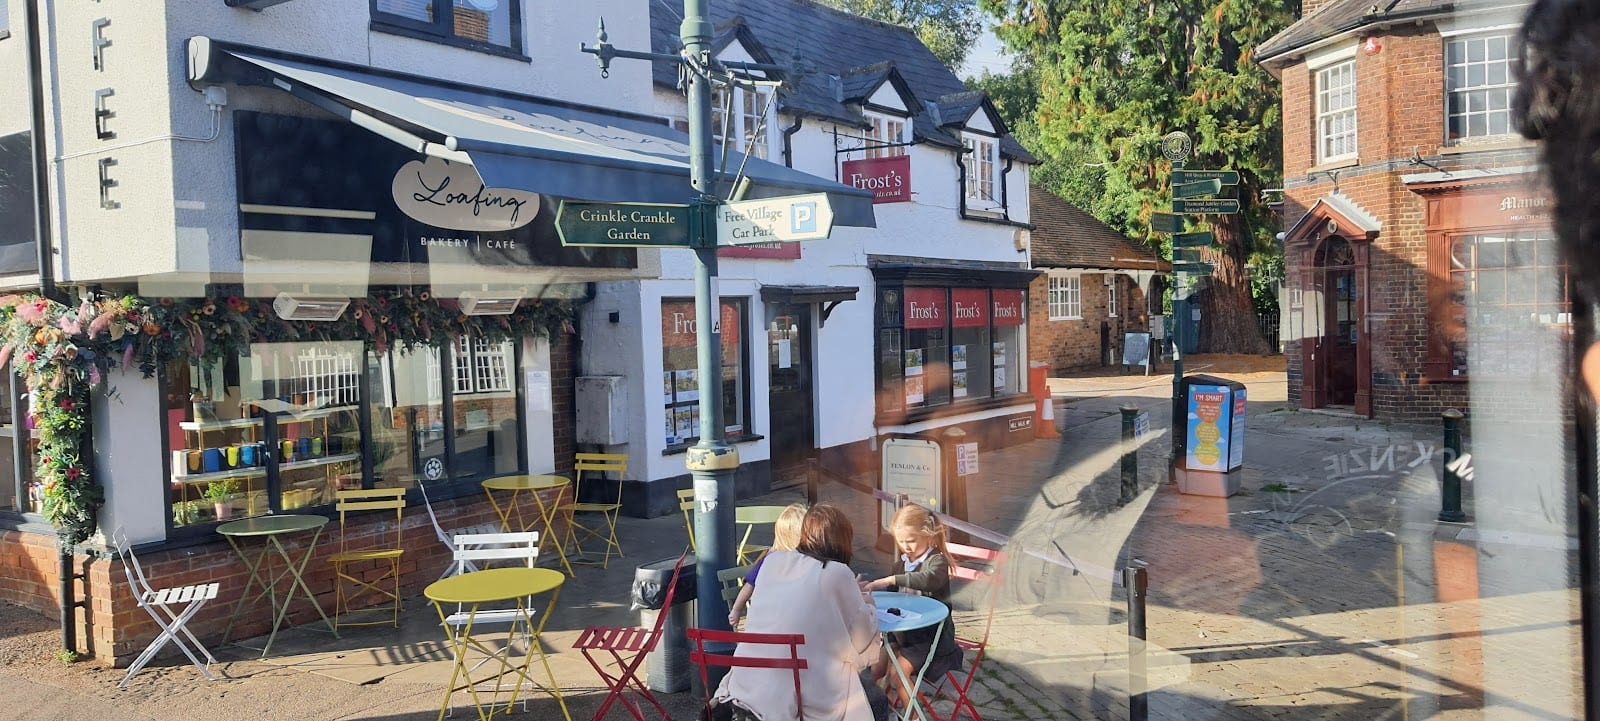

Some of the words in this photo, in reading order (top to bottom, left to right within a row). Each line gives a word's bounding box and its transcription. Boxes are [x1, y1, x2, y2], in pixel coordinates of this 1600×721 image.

[850, 170, 902, 190] Frost's
[413, 171, 527, 227] Loafing
[1499, 196, 1547, 211] Manor
[580, 209, 627, 222] Crinkle
[630, 211, 676, 224] Crankle
[724, 211, 745, 223] Free
[746, 206, 783, 222] Village
[607, 227, 651, 240] Garden
[732, 227, 750, 239] Car
[752, 224, 776, 237] Park
[420, 236, 469, 248] BAKERY
[910, 301, 939, 319] Frost's
[955, 301, 980, 319] Frost's
[994, 301, 1017, 318] Frost's
[1205, 394, 1223, 402] SMART
